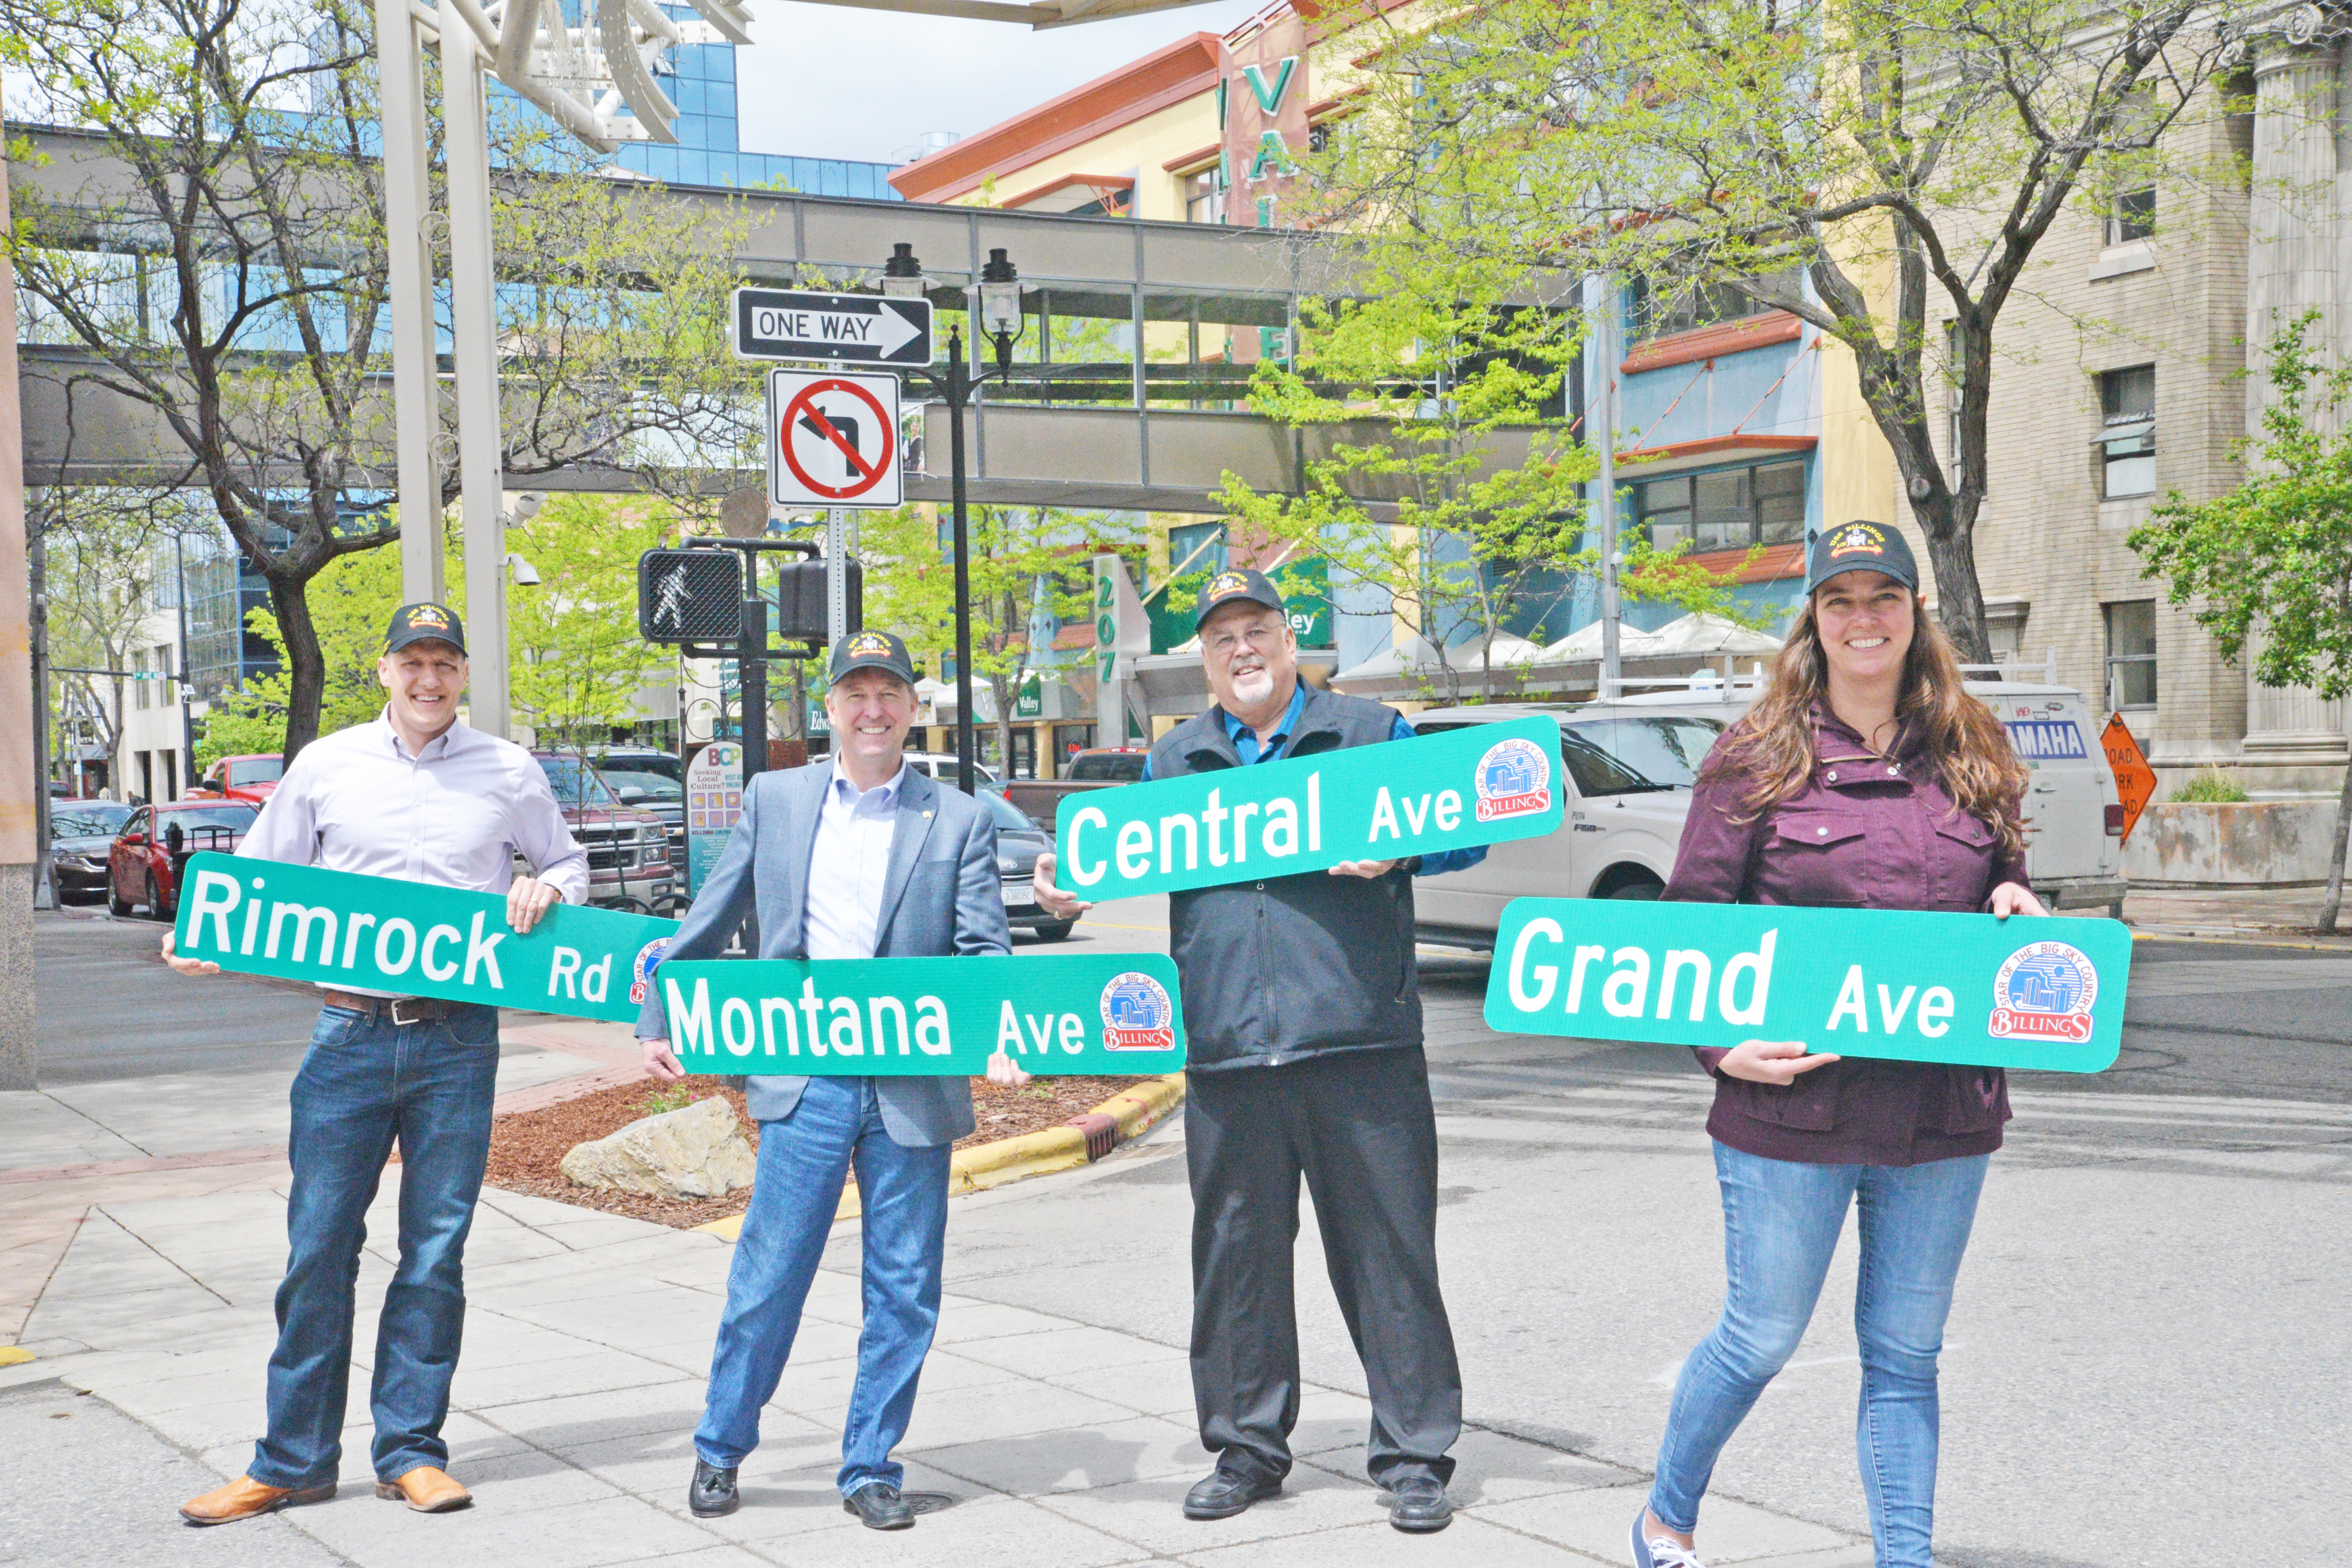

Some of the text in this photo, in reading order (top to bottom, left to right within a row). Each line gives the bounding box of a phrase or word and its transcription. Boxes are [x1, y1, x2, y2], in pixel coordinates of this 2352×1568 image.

[760, 311, 873, 341] ONE WAY
[1829, 523, 1885, 546] USS BILLINGS
[1217, 571, 1248, 582] BILLINGS
[407, 605, 449, 621] USS BILLINGS
[848, 632, 892, 649] USS BILLINGS
[1098, 576, 1115, 682] 207
[1019, 696, 1038, 712] Valley
[1068, 744, 1081, 754] ATM
[2006, 725, 2084, 755] AMAHA
[708, 748, 741, 766] BCP
[1478, 741, 1547, 797] STAR OF THE BIG SKY COUNTRY
[1479, 789, 1547, 817] BILLINGS
[1067, 771, 1462, 886] Central Ave
[185, 870, 611, 1002] Rimrock Rd
[639, 951, 647, 961] OF
[647, 940, 663, 952] THE
[1508, 917, 1954, 1038] Grand Ave
[1998, 944, 2093, 1013] STAR OF THE BIG SKY COUNTRY
[1103, 974, 1169, 1027] STAR OF THE BIG SKY COUNTRY
[665, 975, 1084, 1057] Montana Ave
[1992, 1009, 2089, 1039] BILLINGS
[1106, 1028, 1172, 1048] BILLINGS
